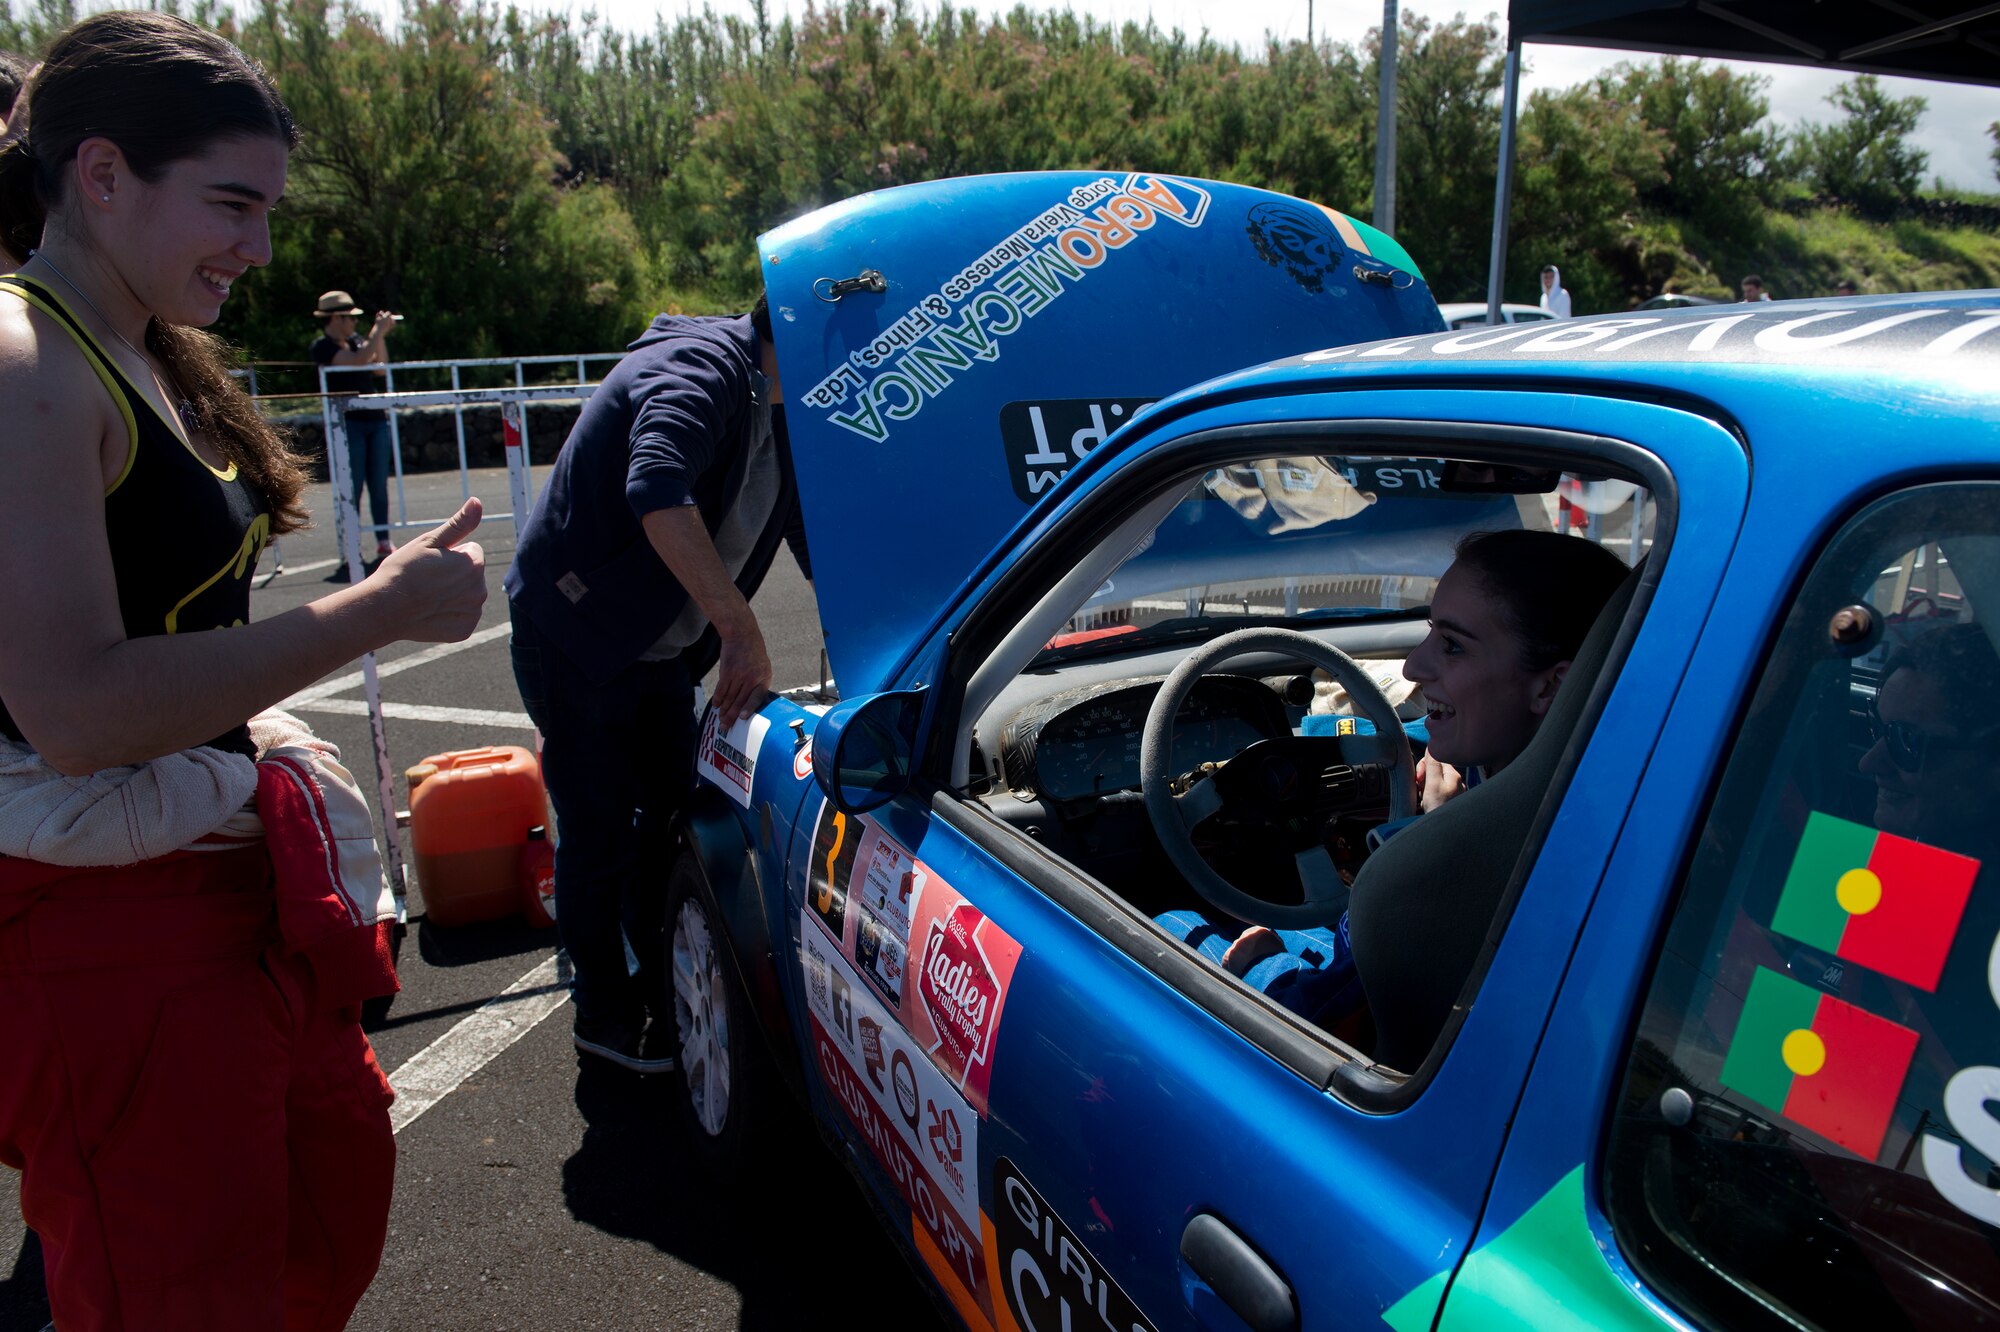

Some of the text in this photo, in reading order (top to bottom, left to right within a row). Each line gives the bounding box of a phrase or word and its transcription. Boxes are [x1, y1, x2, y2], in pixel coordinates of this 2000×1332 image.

[805, 178, 1121, 405] Jorge Vieira Meneses & Filhos, Lda.
[832, 178, 1188, 440] AGROMECÂNICA
[817, 810, 847, 915] 3
[886, 900, 911, 930] CLUBAUTO
[927, 933, 988, 1028] Ladies
[937, 990, 983, 1051] rally trophy
[935, 1013, 967, 1065] CLUBAUTO.PT
[820, 1039, 977, 1290] CLUBAUTO.PT
[943, 1154, 965, 1195] anos
[1005, 1176, 1148, 1332] GIRL
